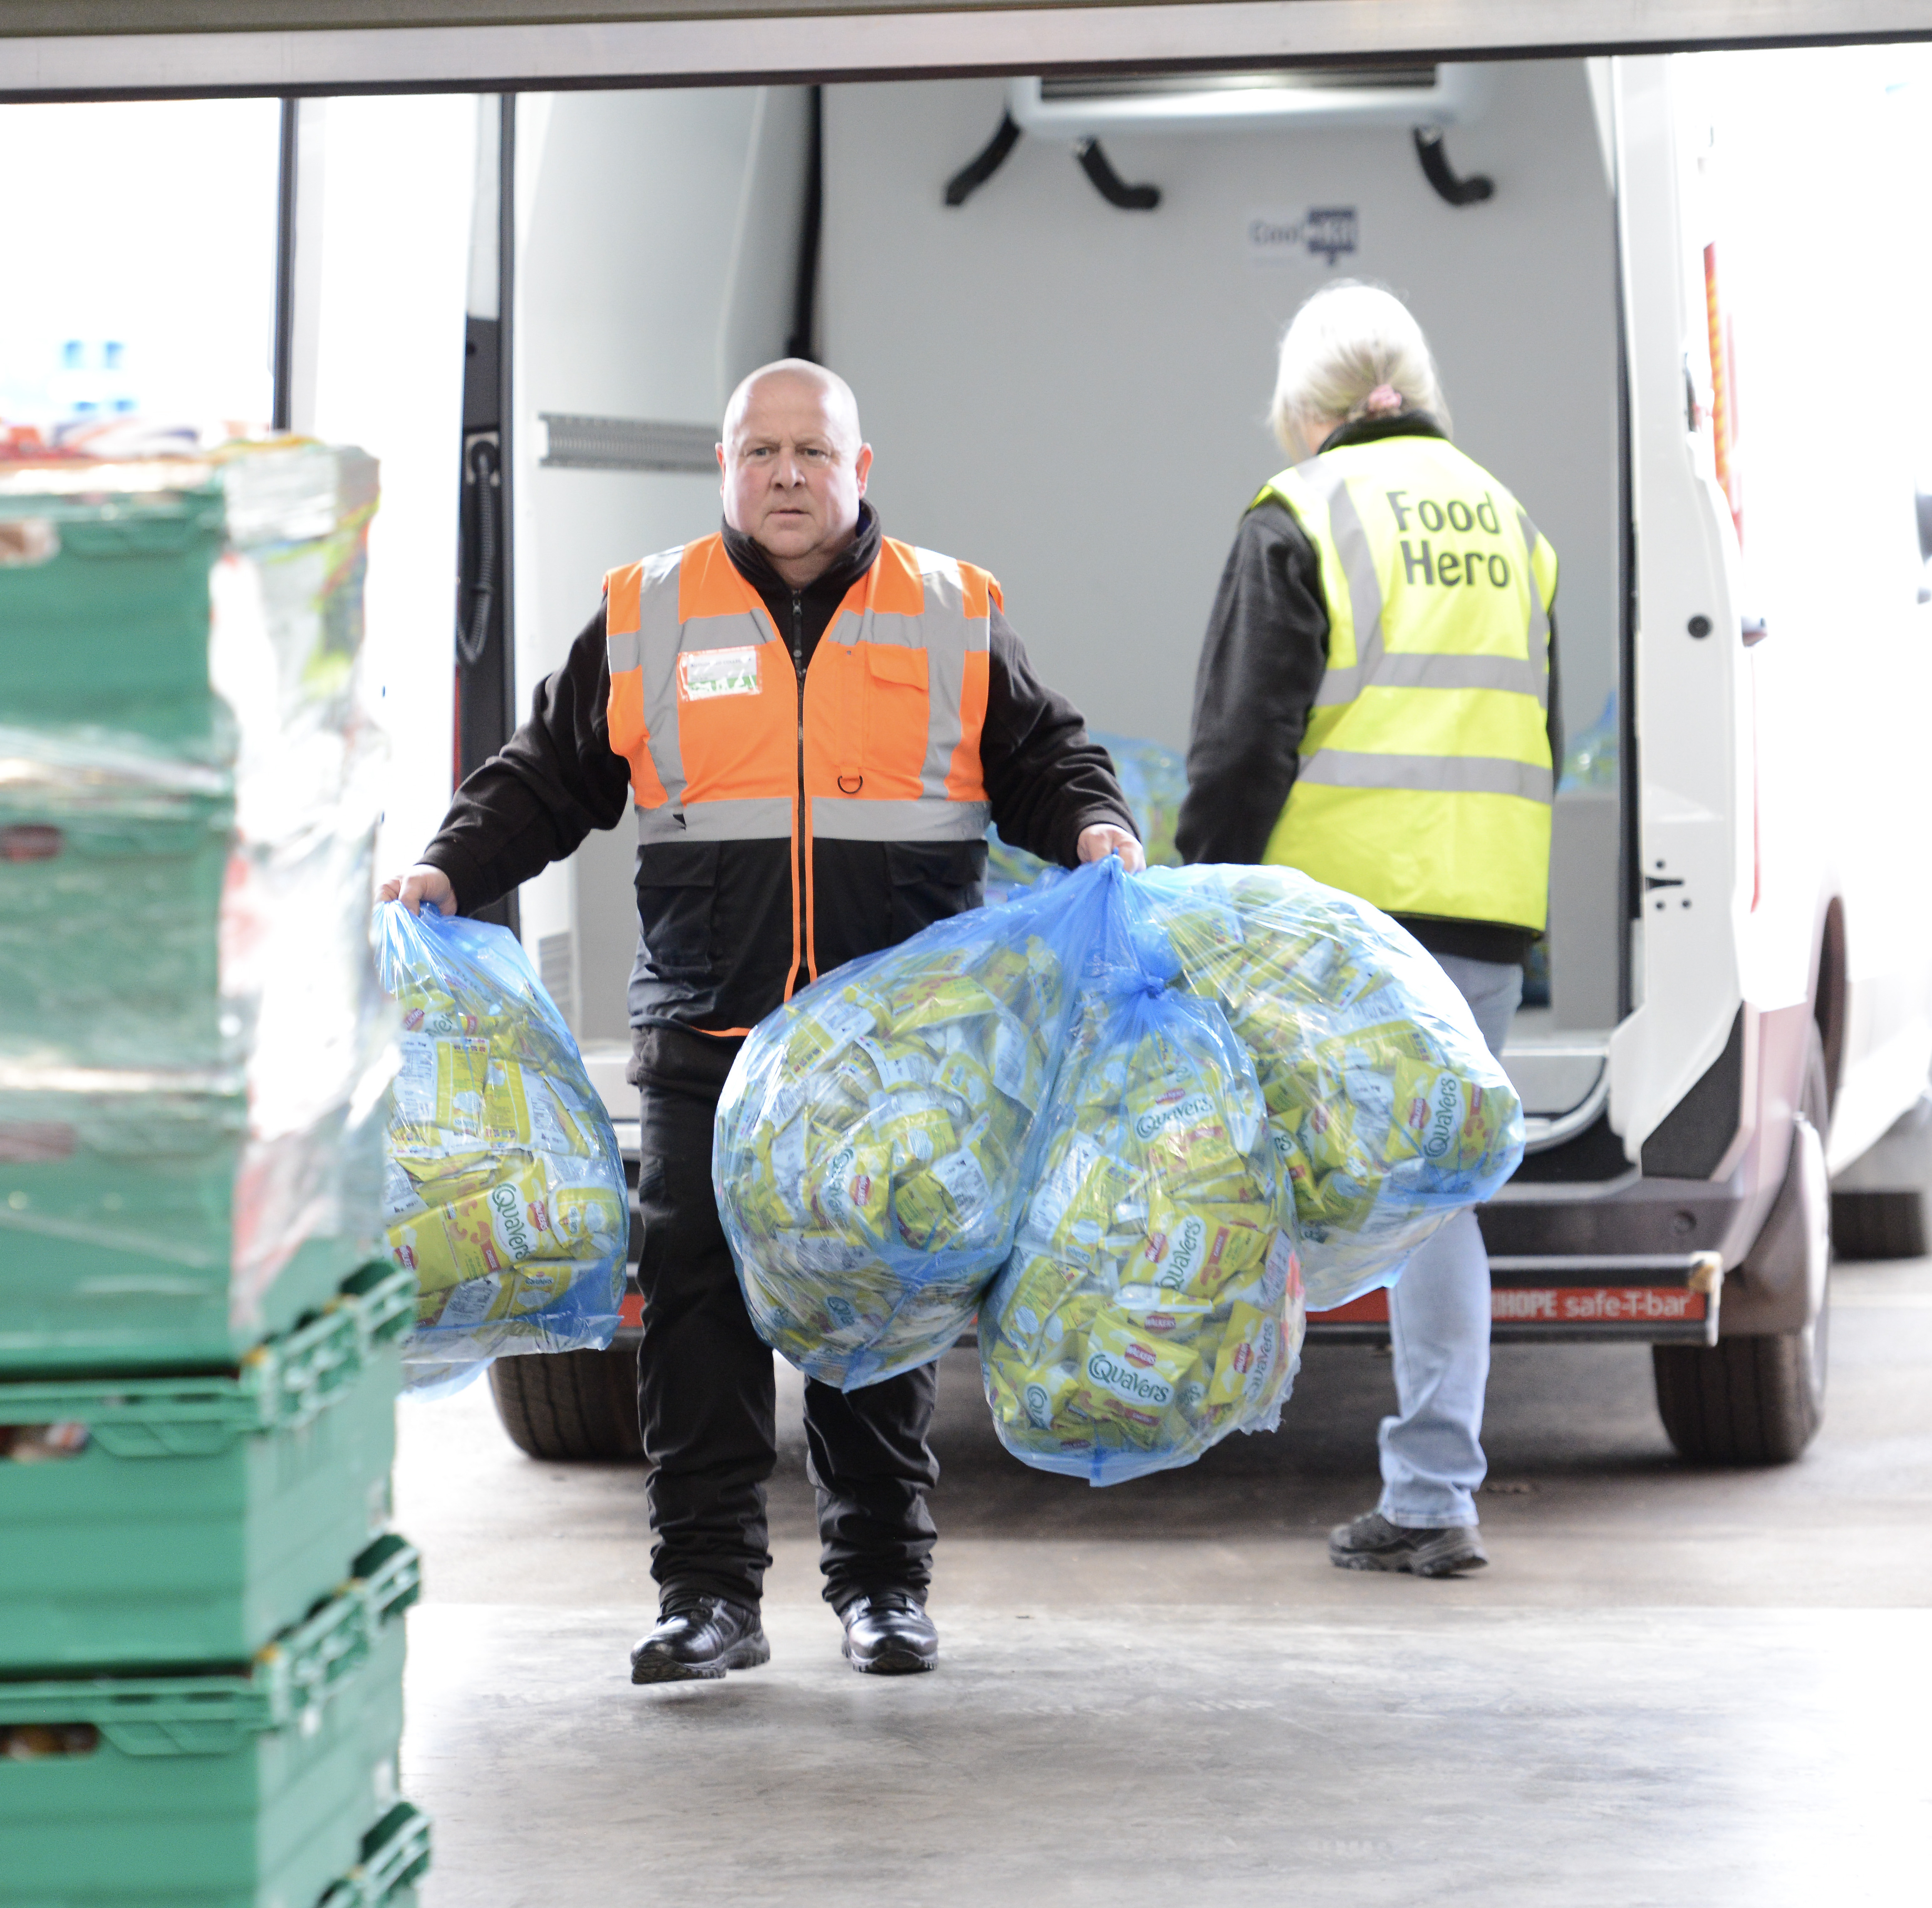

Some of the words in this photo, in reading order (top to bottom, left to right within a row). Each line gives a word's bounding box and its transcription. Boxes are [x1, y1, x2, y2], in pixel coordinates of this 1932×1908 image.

[1386, 491, 1501, 534] Food
[1400, 540, 1510, 587] Hero
[1137, 1099, 1213, 1138] Quavers
[1424, 1079, 1456, 1157] Quavers
[492, 1183, 530, 1260] Quavers
[1088, 1354, 1169, 1402] Quavers
